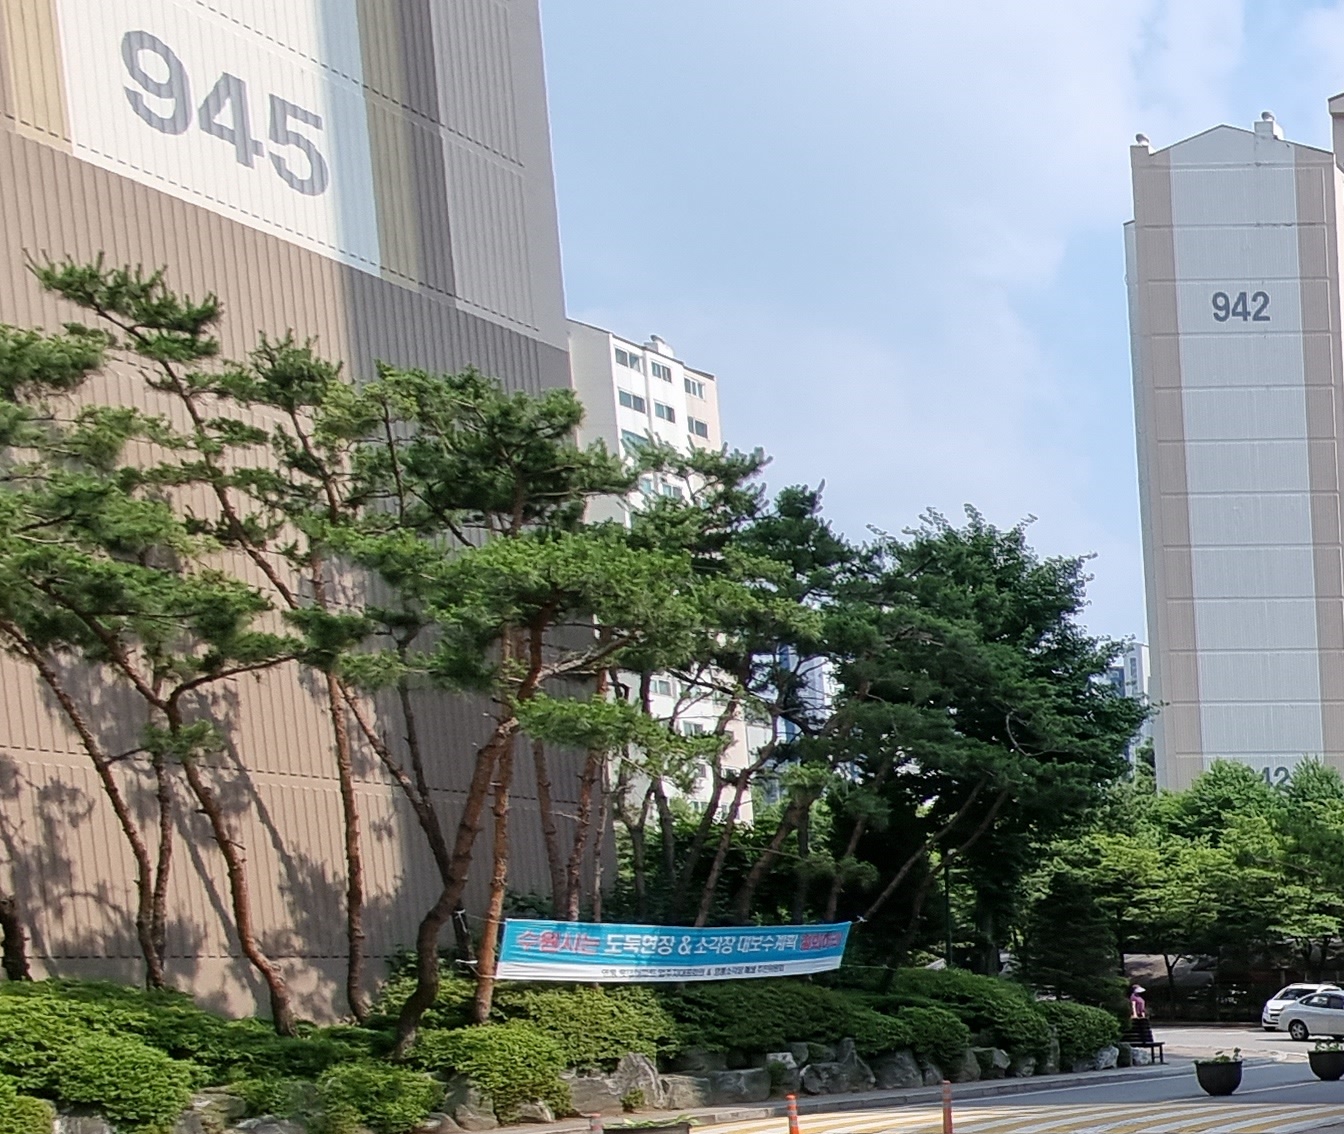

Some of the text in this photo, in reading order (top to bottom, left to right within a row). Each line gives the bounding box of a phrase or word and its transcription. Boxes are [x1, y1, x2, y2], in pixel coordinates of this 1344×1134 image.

[121, 29, 330, 197] 945
[1211, 291, 1271, 322] 942
[678, 935, 692, 955] &
